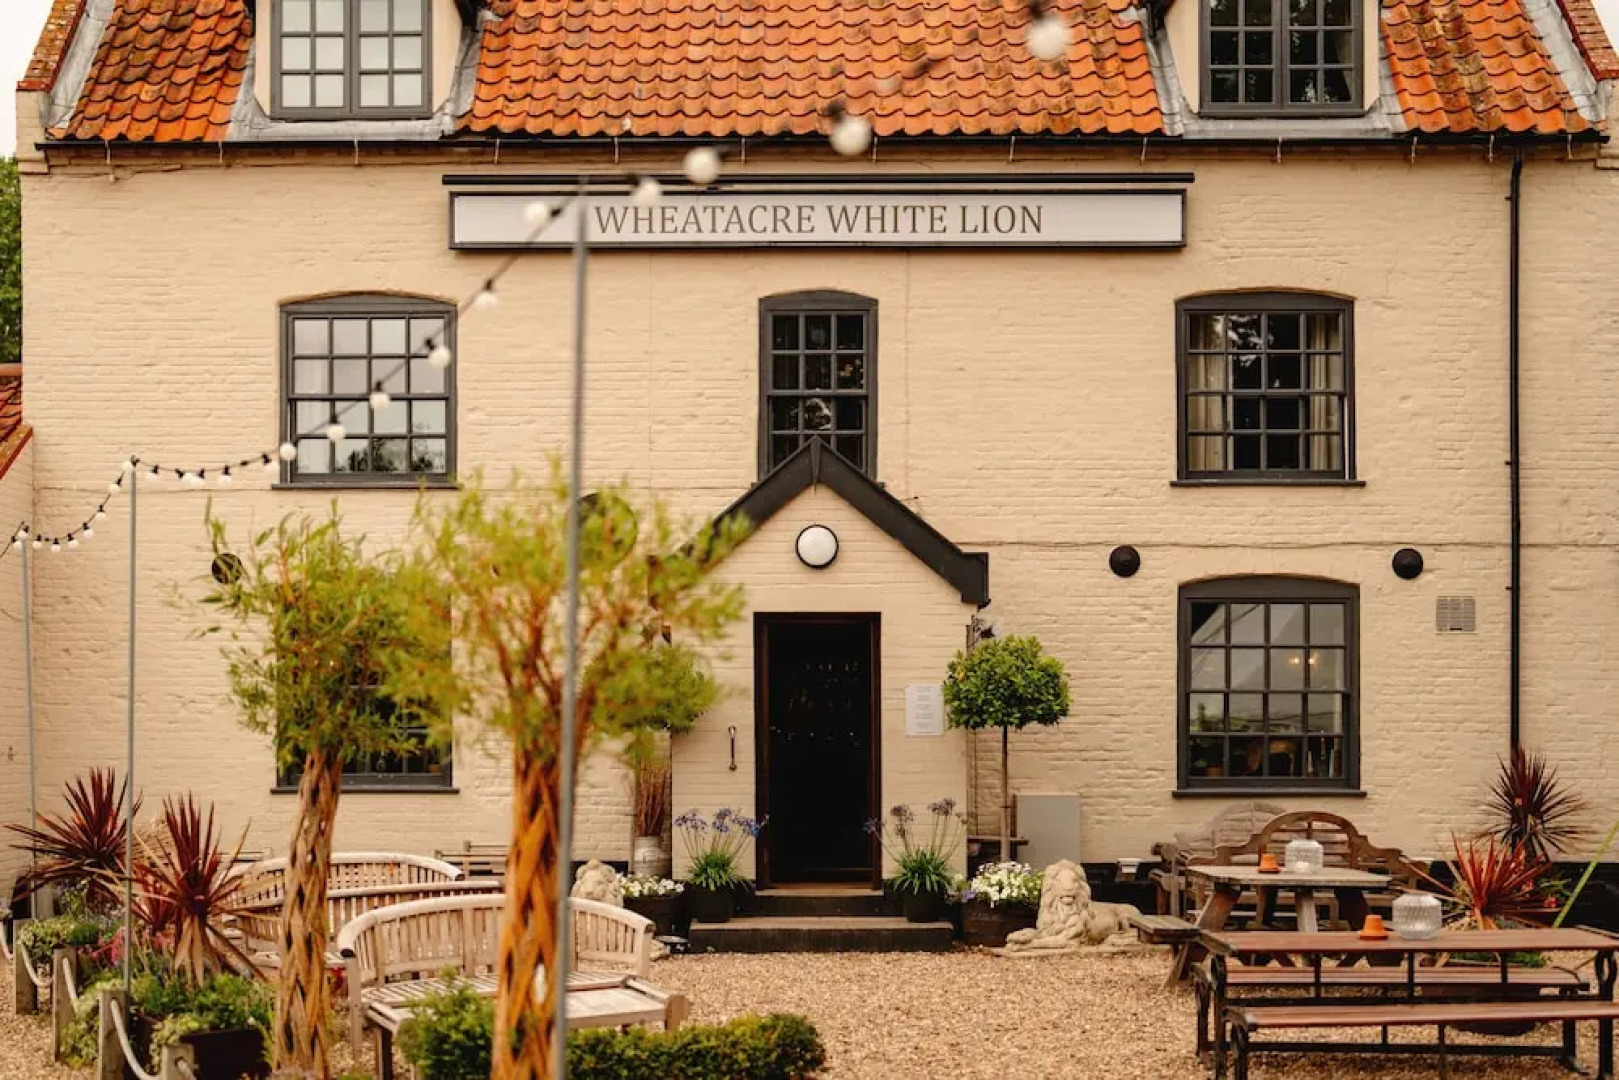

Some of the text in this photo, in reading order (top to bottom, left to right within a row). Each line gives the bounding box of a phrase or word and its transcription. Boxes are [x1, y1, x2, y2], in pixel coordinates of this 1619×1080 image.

[594, 205, 1043, 234] WHEATACRE WHITE LION
